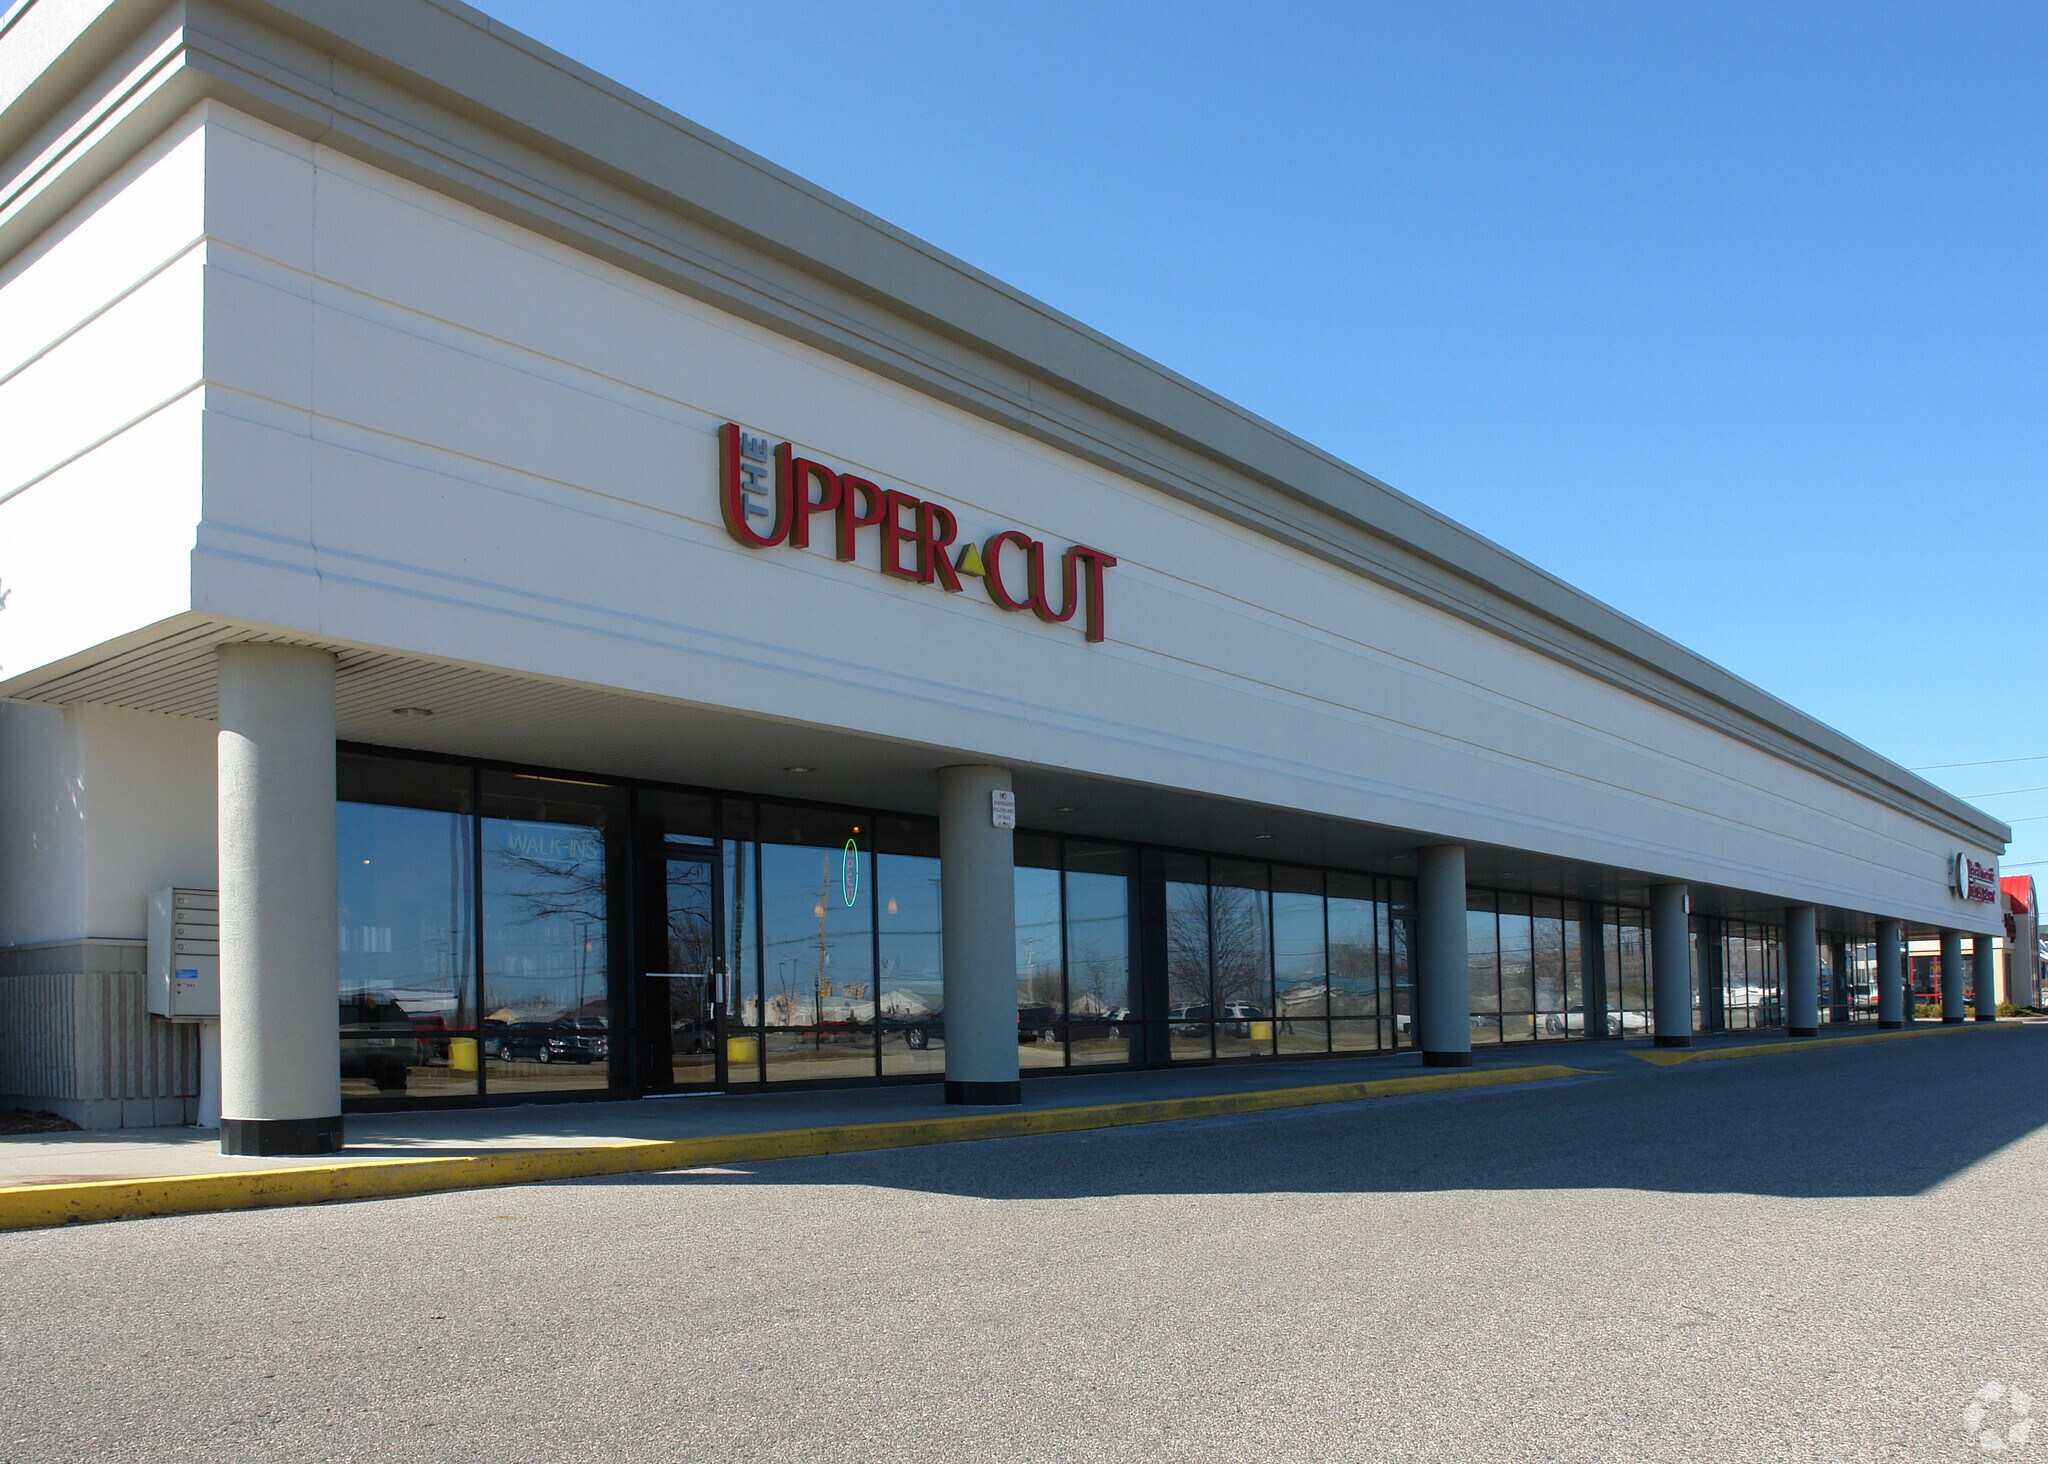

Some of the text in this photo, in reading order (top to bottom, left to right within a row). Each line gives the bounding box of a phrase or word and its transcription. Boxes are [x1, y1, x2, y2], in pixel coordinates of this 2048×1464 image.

[742, 432, 769, 520] THE
[719, 422, 1118, 643] UPPER CUT
[508, 832, 598, 860] WALK-INS
